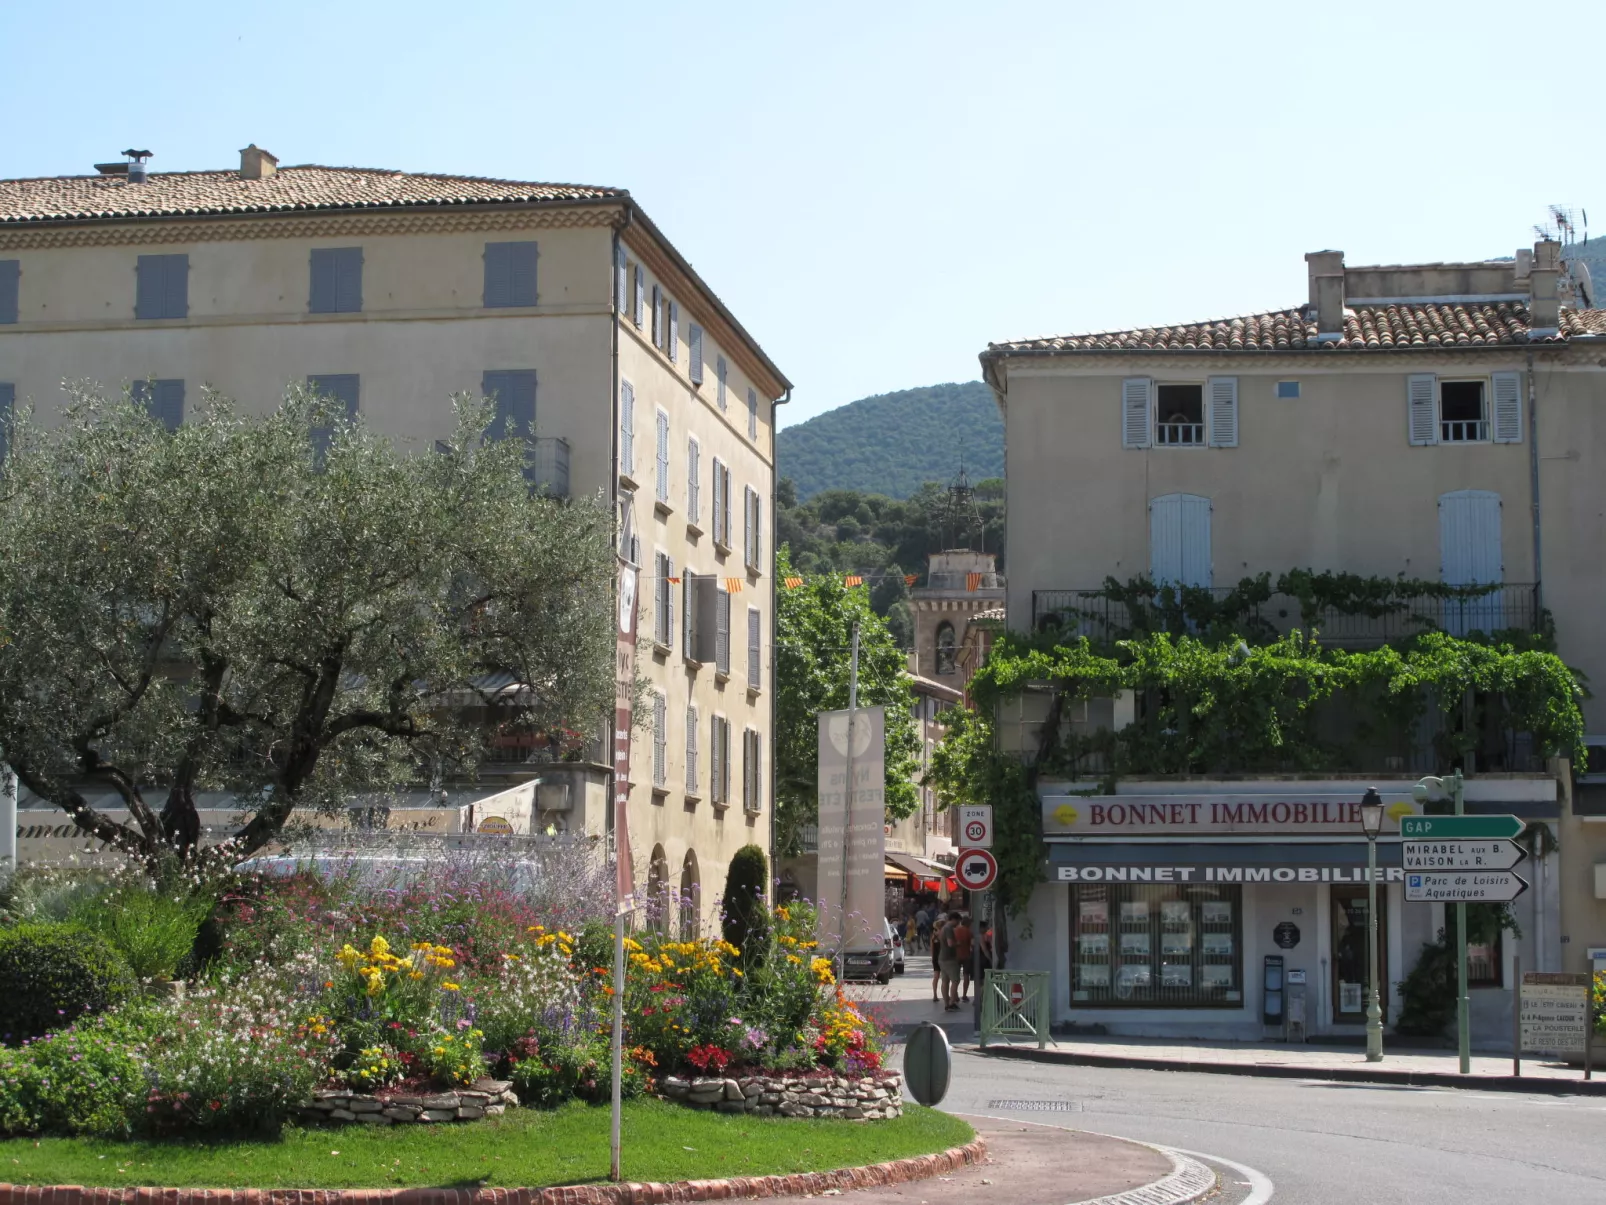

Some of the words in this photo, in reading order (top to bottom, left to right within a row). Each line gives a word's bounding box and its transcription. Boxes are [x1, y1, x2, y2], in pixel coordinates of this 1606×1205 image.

[1089, 804, 1202, 826] BONNET
[1210, 802, 1363, 825] IMMOBILIE
[970, 827, 982, 836] 30
[1405, 822, 1432, 833] GAP
[1406, 845, 1464, 854] MIRABEL
[1493, 844, 1504, 854] B.
[1406, 857, 1454, 866] VAISON
[1475, 857, 1487, 866] R.
[1058, 867, 1195, 881] BONNET
[1205, 867, 1404, 882] IMMOBILIER
[1424, 876, 1448, 886] Parc
[1455, 876, 1467, 885] de
[1474, 876, 1509, 886] Loisirs
[1425, 888, 1485, 899] Aquatiques
